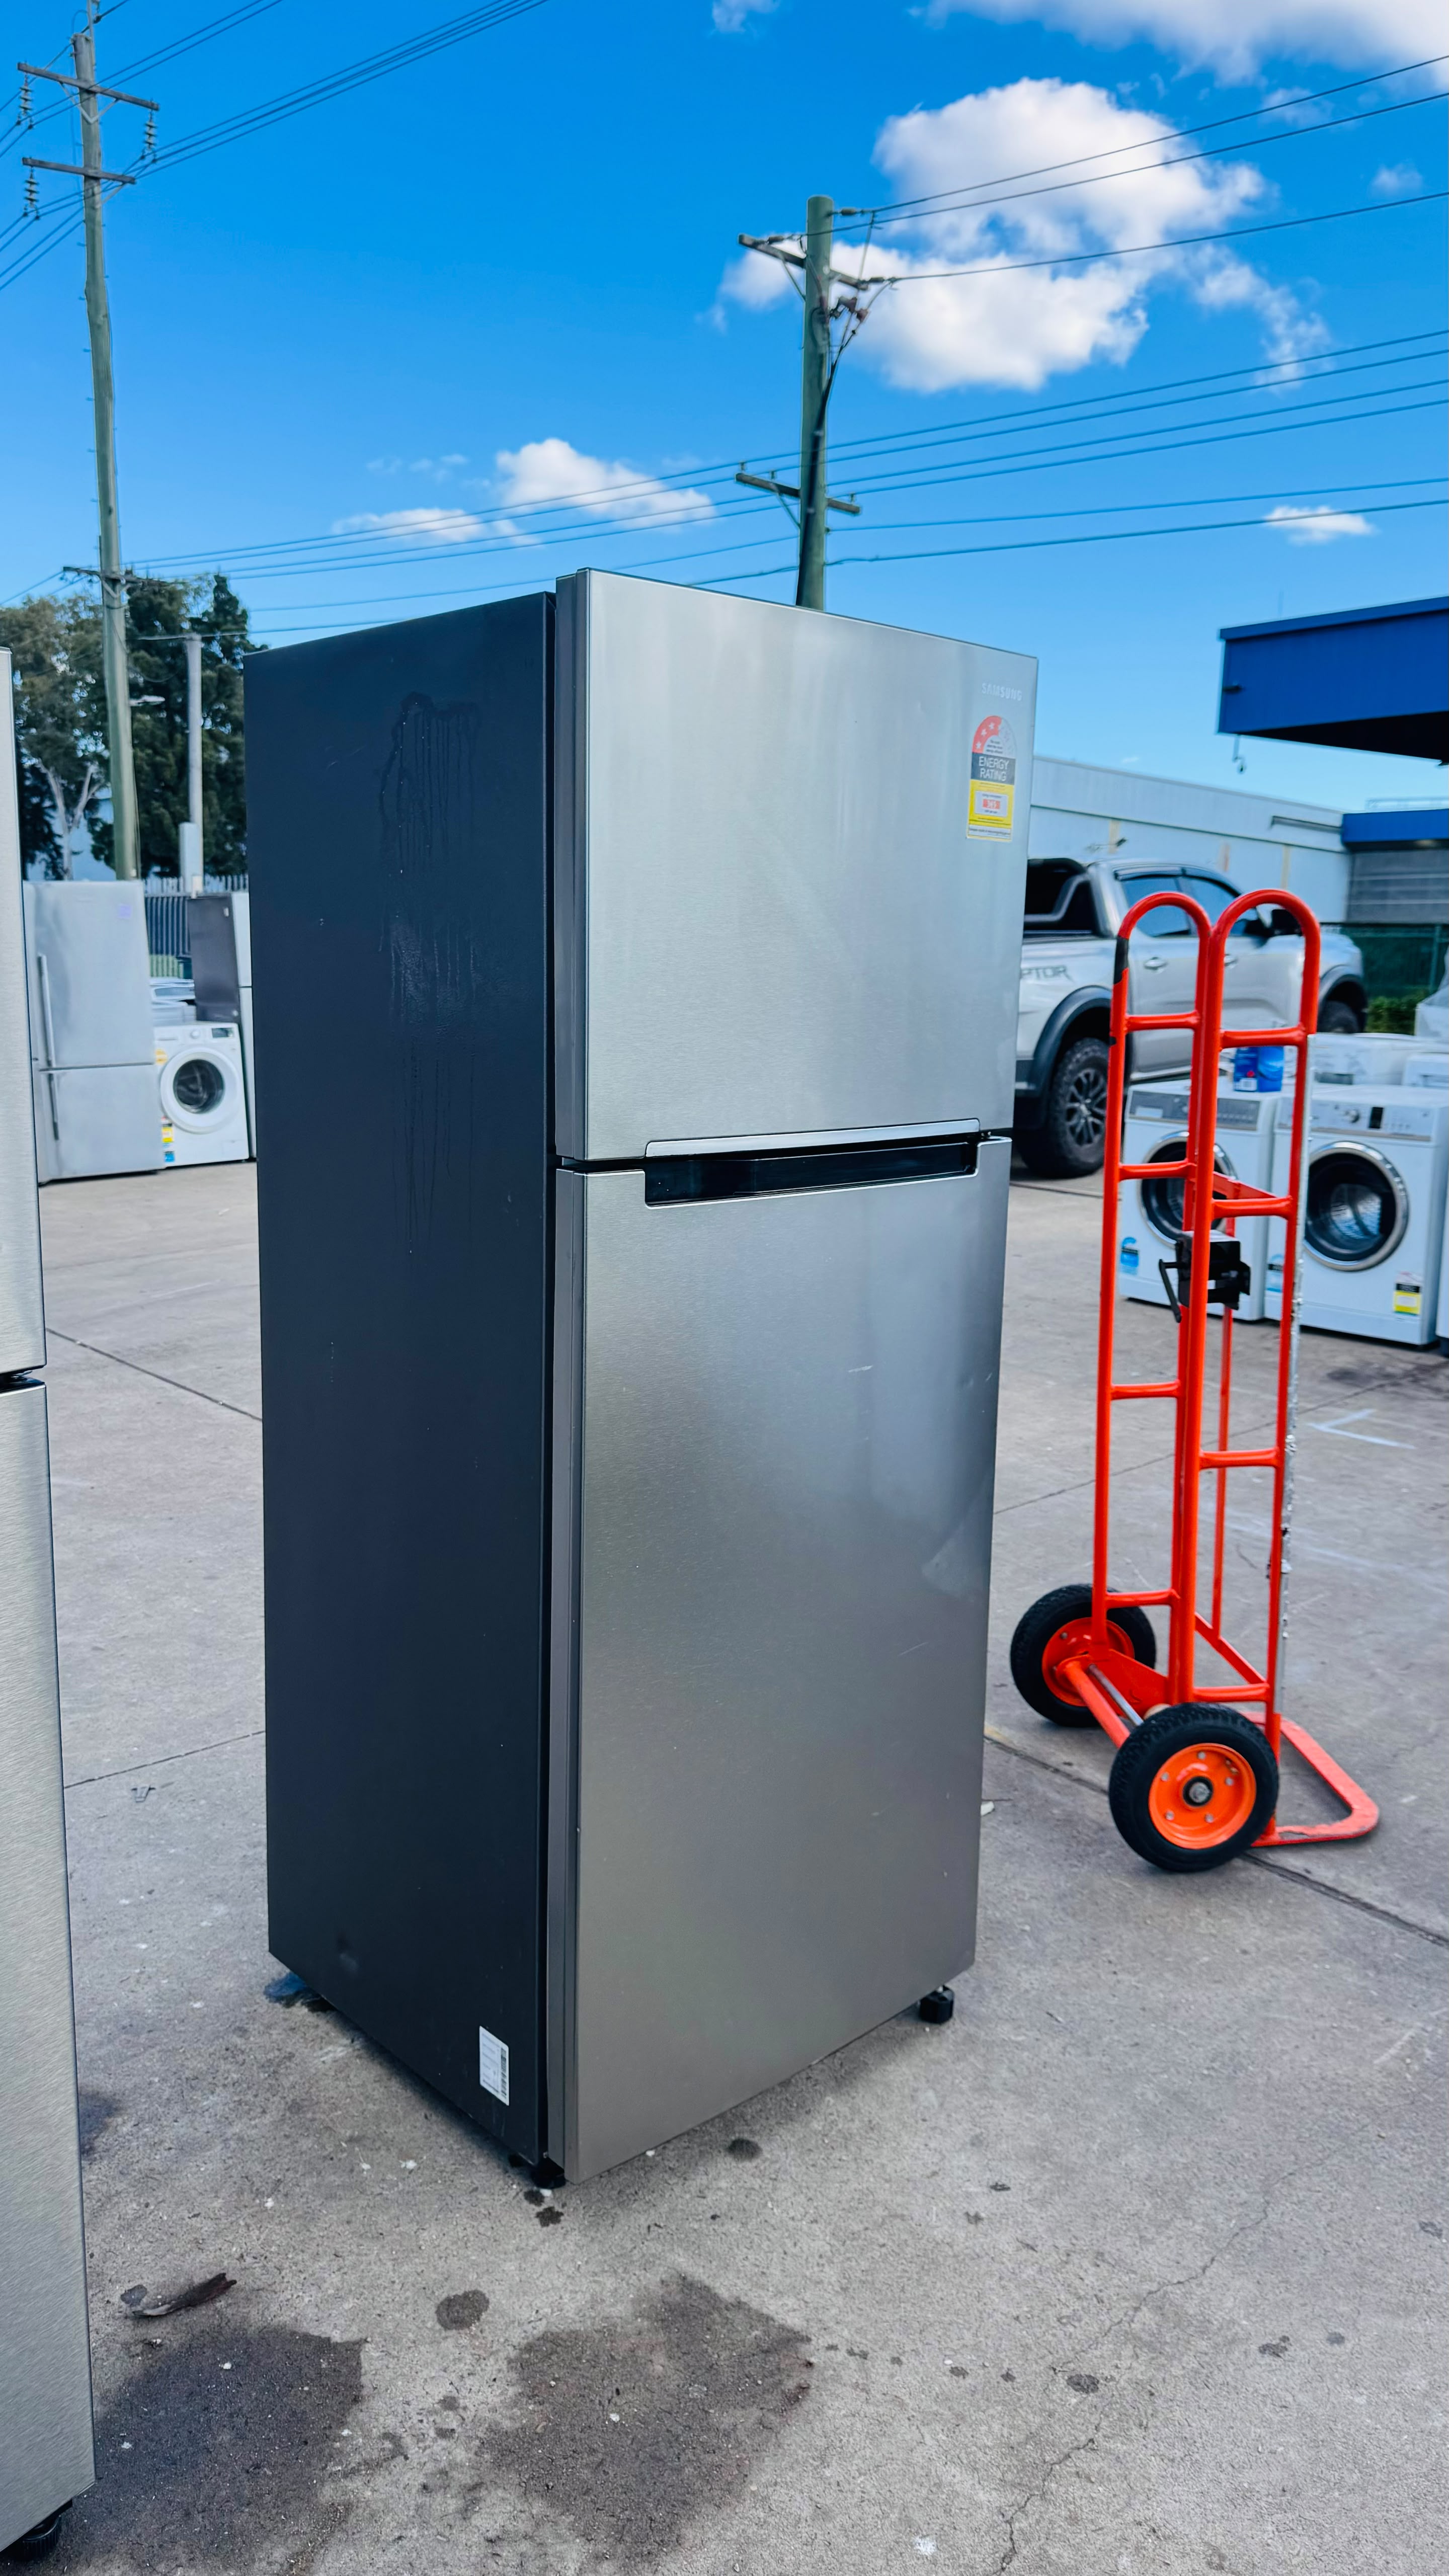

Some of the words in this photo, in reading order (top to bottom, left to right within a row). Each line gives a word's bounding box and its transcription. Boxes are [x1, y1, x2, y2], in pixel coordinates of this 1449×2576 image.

[982, 683, 1022, 701] SAMSUNG
[979, 756, 1009, 770] ENERGY
[980, 768, 1006, 781] RATING
